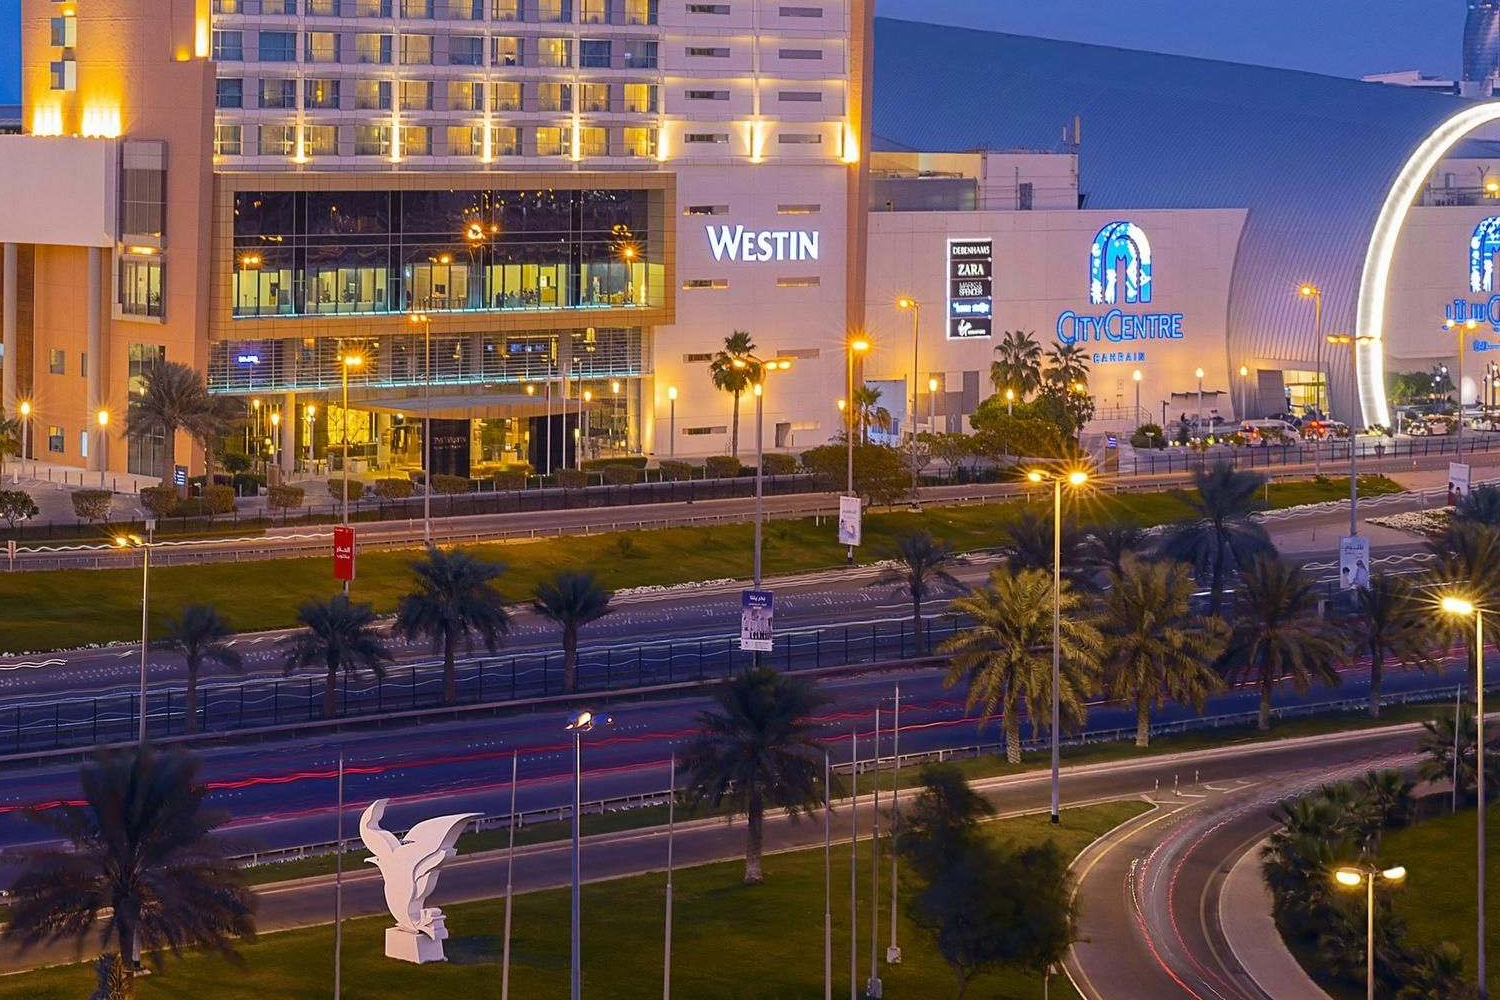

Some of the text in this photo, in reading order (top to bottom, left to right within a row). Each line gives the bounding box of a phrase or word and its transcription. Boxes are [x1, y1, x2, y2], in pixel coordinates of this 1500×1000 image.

[706, 225, 819, 261] WESTIN
[953, 246, 990, 255] DEBENHAMS
[958, 264, 984, 276] ZARA
